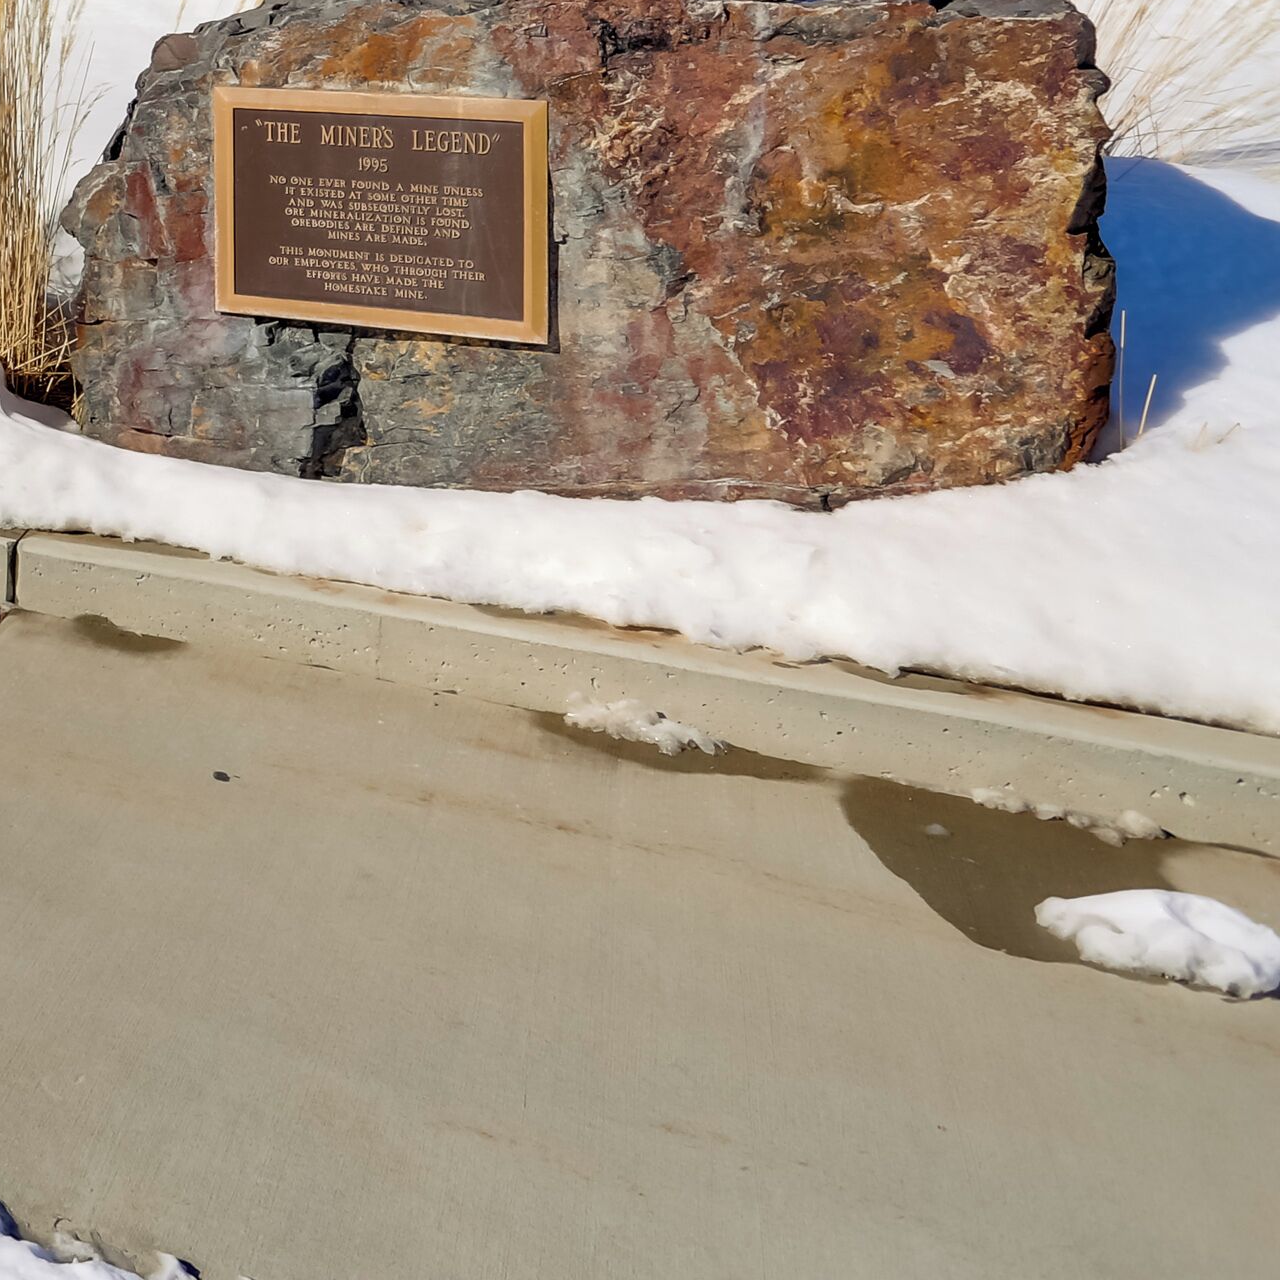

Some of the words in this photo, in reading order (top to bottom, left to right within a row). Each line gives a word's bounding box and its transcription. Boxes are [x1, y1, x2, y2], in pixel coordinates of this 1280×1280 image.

[320, 124, 394, 149] MINER'S
[358, 156, 388, 173] 1995
[269, 175, 286, 185] NO
[290, 176, 313, 187] ONE
[319, 178, 346, 188] EVER
[351, 180, 390, 191] FOUND
[396, 183, 404, 192] A
[410, 183, 439, 194] MINE
[443, 186, 483, 197] UNLESS
[285, 186, 296, 195] IT
[300, 187, 345, 199] EXISTED
[348, 191, 362, 200] AT
[367, 192, 396, 202] SOME
[401, 194, 438, 205] OTHER
[442, 196, 469, 207] TIME
[284, 207, 305, 217] ORE
[310, 209, 411, 226] MINERALIZATION
[416, 217, 426, 226] IS
[288, 198, 315, 208] AND
[320, 200, 344, 209] WAS
[348, 201, 431, 216] SUBSEQUENTLY
[436, 207, 465, 218] LOST.
[291, 217, 350, 230] OREBODIES
[354, 222, 375, 232] ARE
[381, 224, 429, 236] DEFINED
[433, 228, 460, 239] AND
[327, 230, 360, 241] MINES
[365, 234, 387, 243] ARE
[279, 245, 304, 256] THIS
[308, 247, 370, 260] MONUMENT
[375, 253, 385, 262] IS
[390, 254, 454, 267] DEDICATED
[458, 259, 474, 269] TO
[268, 256, 289, 266] OUR
[294, 258, 358, 271] EMPLOYEES,
[361, 263, 389, 273] WHO
[393, 265, 447, 279] THROUGH
[452, 270, 486, 281] THEIR
[306, 269, 348, 281] EFFORTS
[352, 273, 380, 284] HAVE
[385, 276, 418, 287] MADE
[422, 279, 445, 289] THE
[324, 282, 387, 296] HOMESTAKE
[394, 288, 428, 300] MINE.
